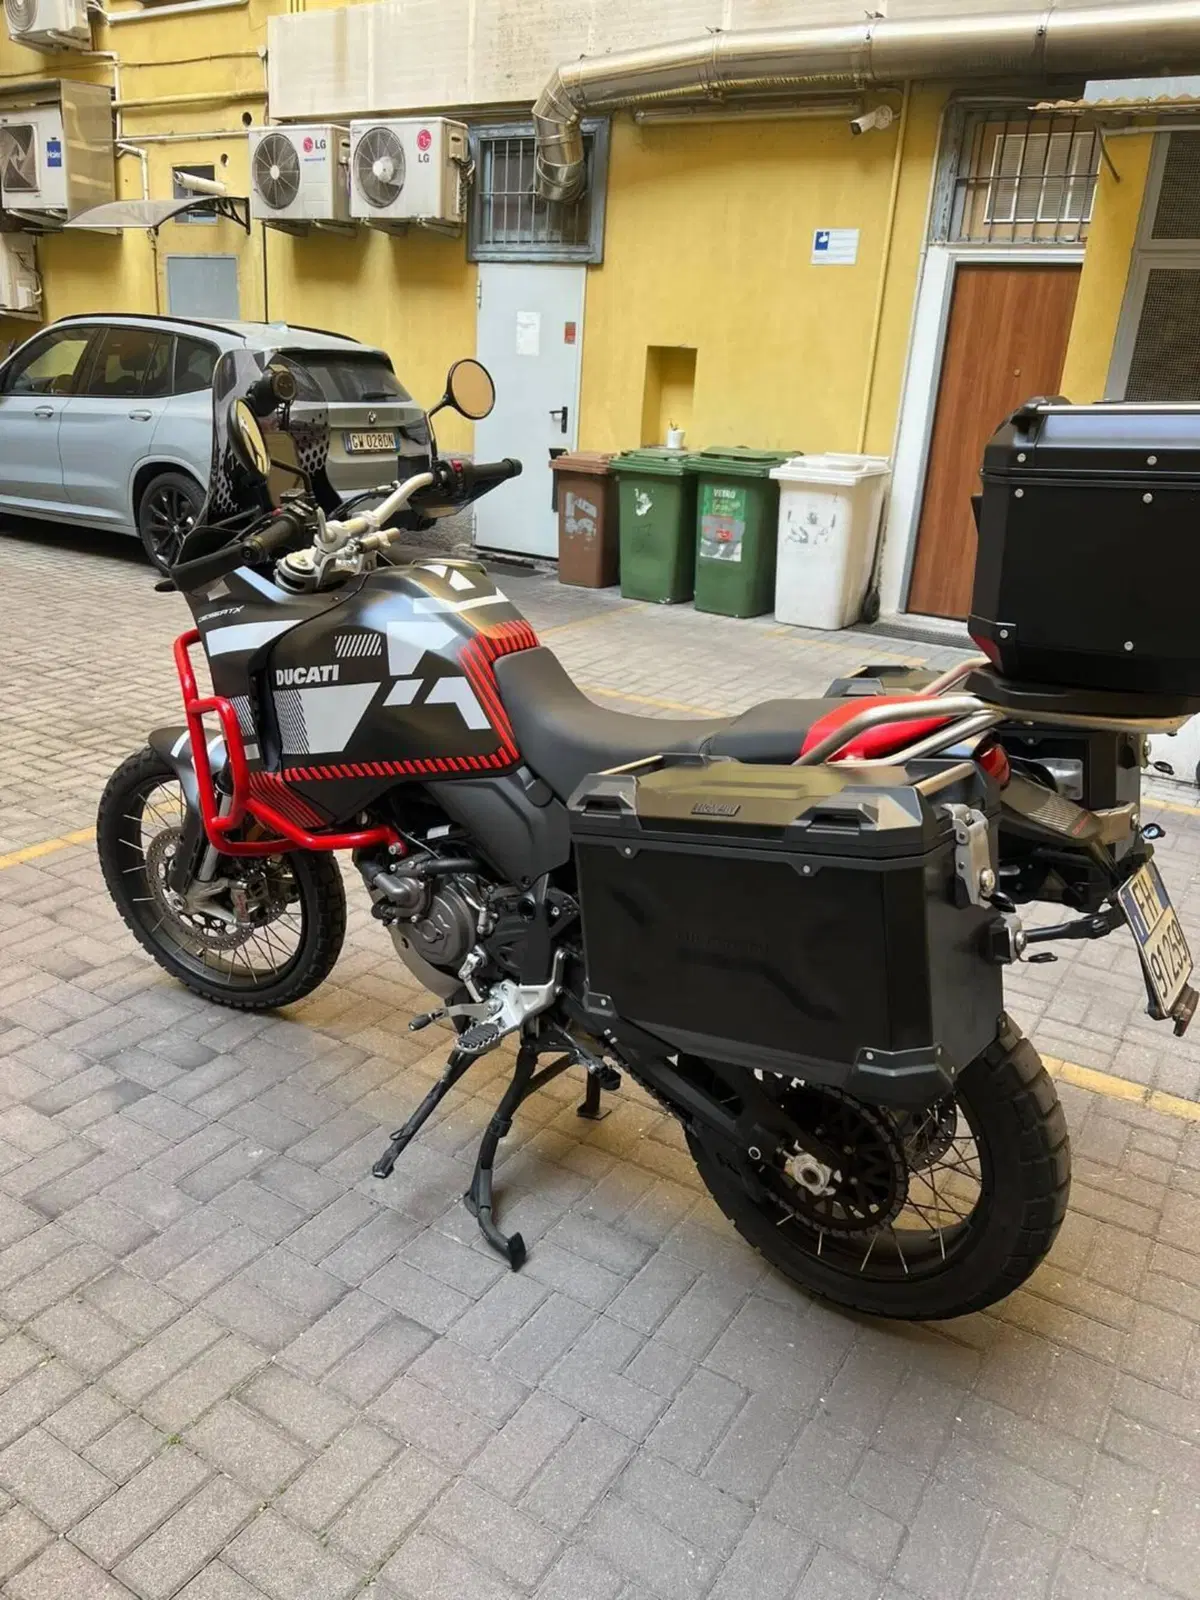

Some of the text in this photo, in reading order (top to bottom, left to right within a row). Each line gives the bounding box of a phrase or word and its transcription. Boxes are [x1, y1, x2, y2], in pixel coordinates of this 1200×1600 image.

[315, 138, 326, 149] LG
[418, 153, 430, 163] LG
[275, 664, 340, 686] DUCATI
[1131, 874, 1159, 931] FH
[1150, 918, 1188, 999] 91259
